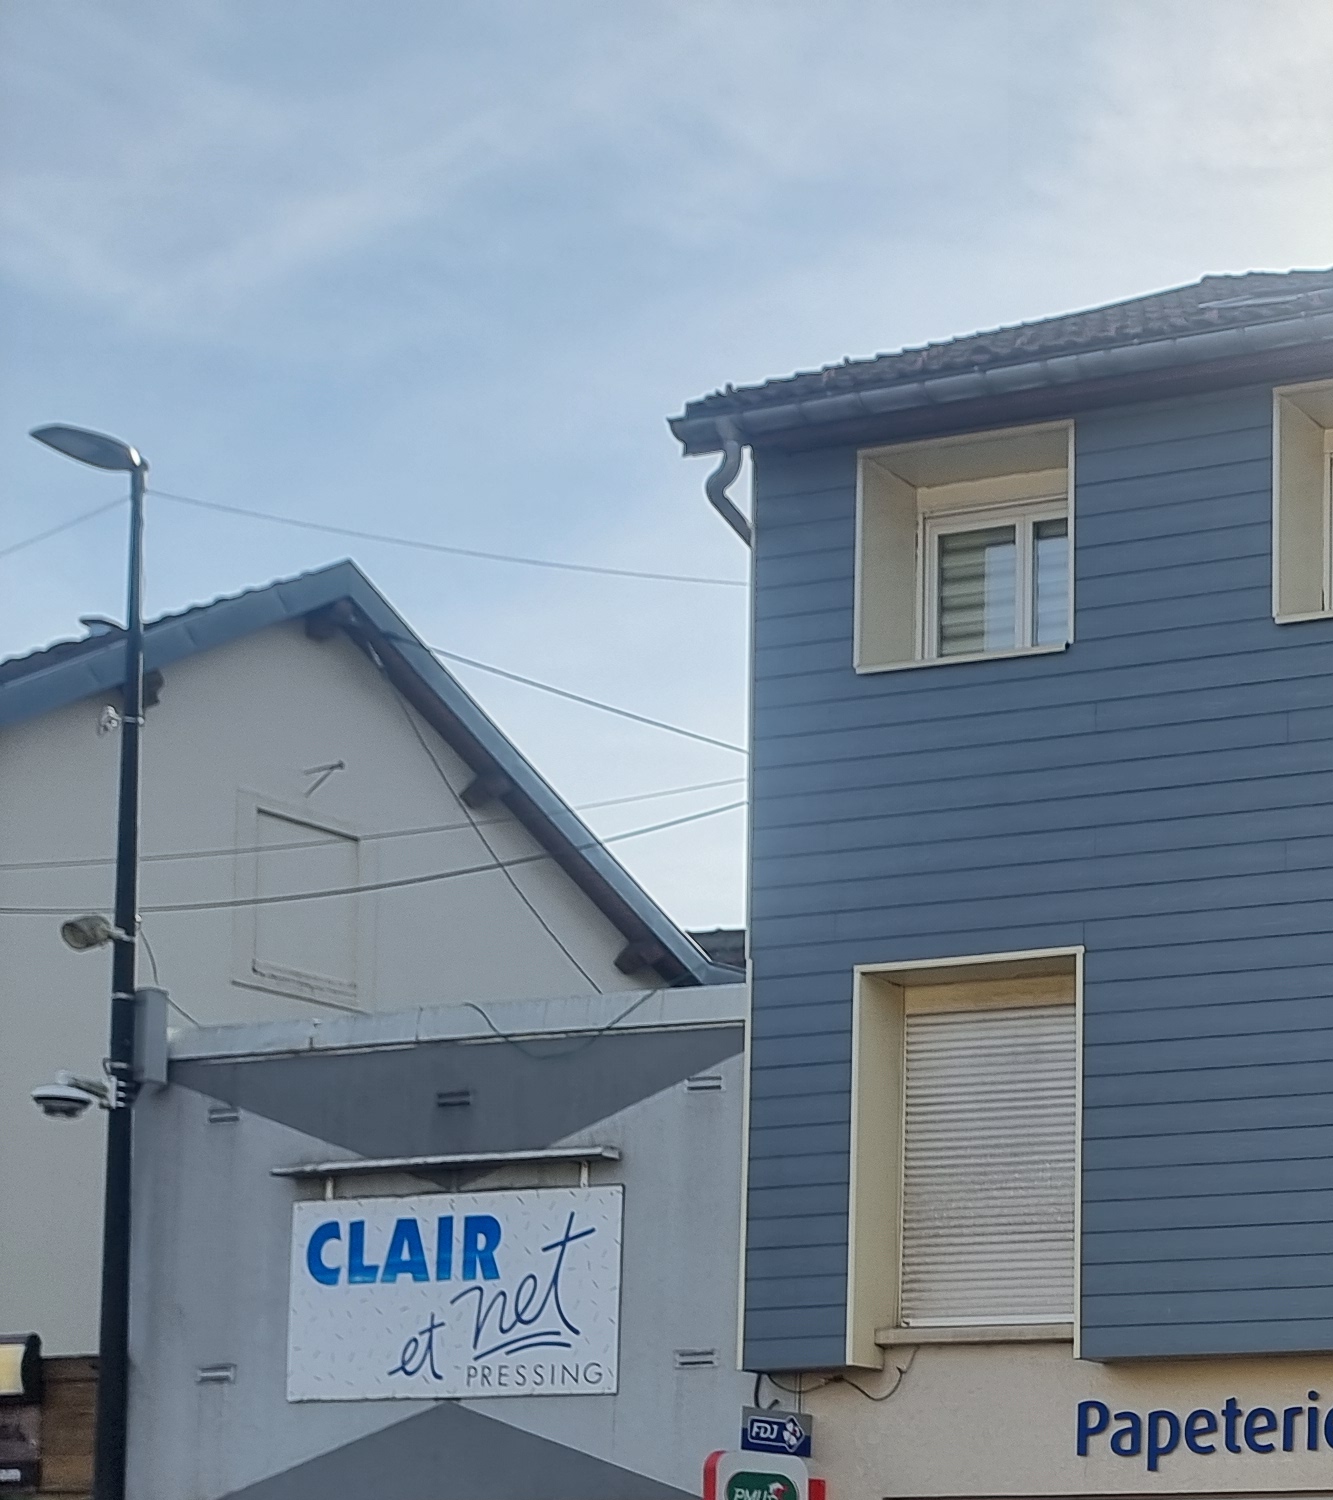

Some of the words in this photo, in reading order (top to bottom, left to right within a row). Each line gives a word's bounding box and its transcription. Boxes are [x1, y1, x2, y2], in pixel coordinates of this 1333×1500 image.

[306, 1214, 502, 1286] CLAIR
[387, 1311, 444, 1380] et
[449, 1211, 597, 1350] net
[466, 1361, 603, 1388] PRESSING
[751, 1421, 780, 1440] FDJ
